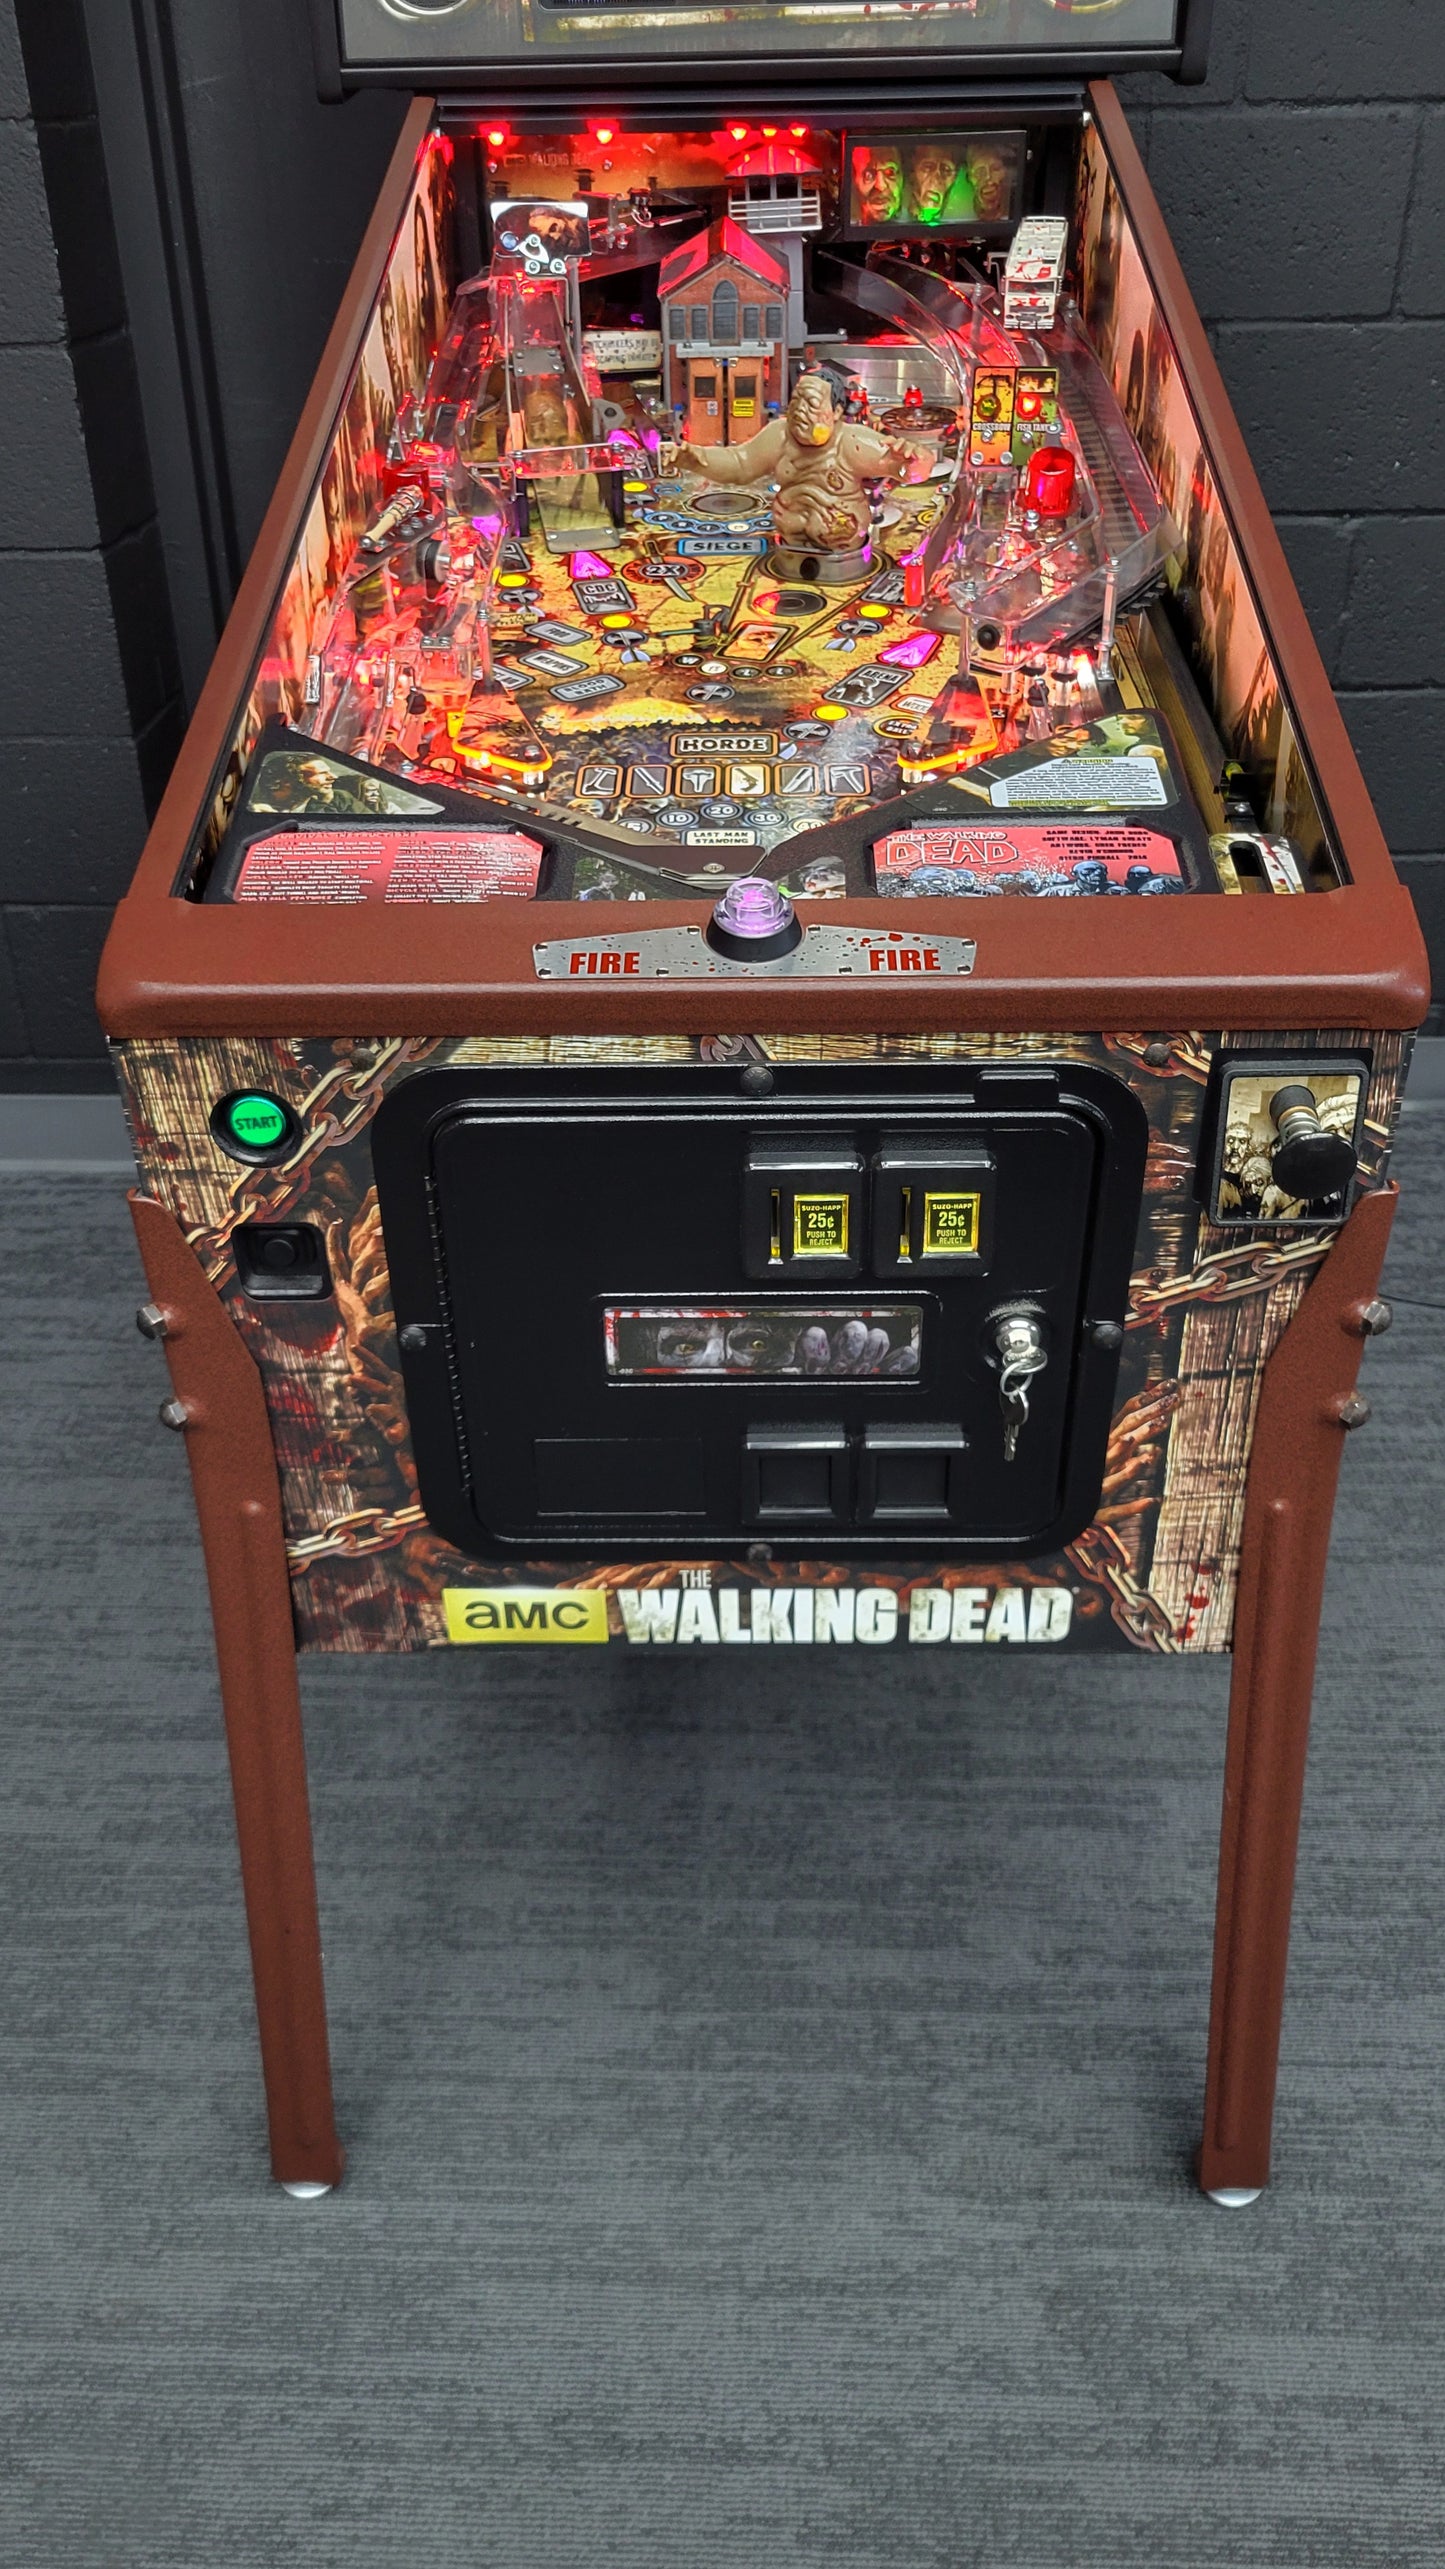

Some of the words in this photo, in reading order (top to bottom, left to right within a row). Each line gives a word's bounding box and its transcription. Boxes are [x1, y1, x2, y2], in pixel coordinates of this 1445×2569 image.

[693, 541, 753, 552] SIEGE
[646, 564, 681, 577] 2X
[584, 583, 617, 595] CDC
[862, 670, 901, 684] ARENA
[681, 737, 769, 753] HORDE
[708, 805, 733, 816] 20
[666, 813, 688, 823] 10
[753, 812, 778, 823] 30
[926, 831, 1008, 841] WALKING
[886, 840, 1018, 866] DEAD
[569, 952, 641, 975] FIRE
[869, 949, 941, 972] FIRE
[234, 1115, 278, 1131] START
[801, 1204, 841, 1212] SUZO-HAPP
[808, 1213, 835, 1229] 25¢
[938, 1211, 965, 1228] 25¢
[806, 1230, 826, 1239] PUSH
[827, 1230, 837, 1239] TO
[936, 1229, 955, 1238] PUSH
[956, 1229, 967, 1238] TO
[809, 1238, 833, 1247] REJECT
[939, 1236, 963, 1245] REJECT
[679, 1569, 712, 1589] THE
[616, 1587, 899, 1644] WALKING
[908, 1587, 1075, 1644] DEAD
